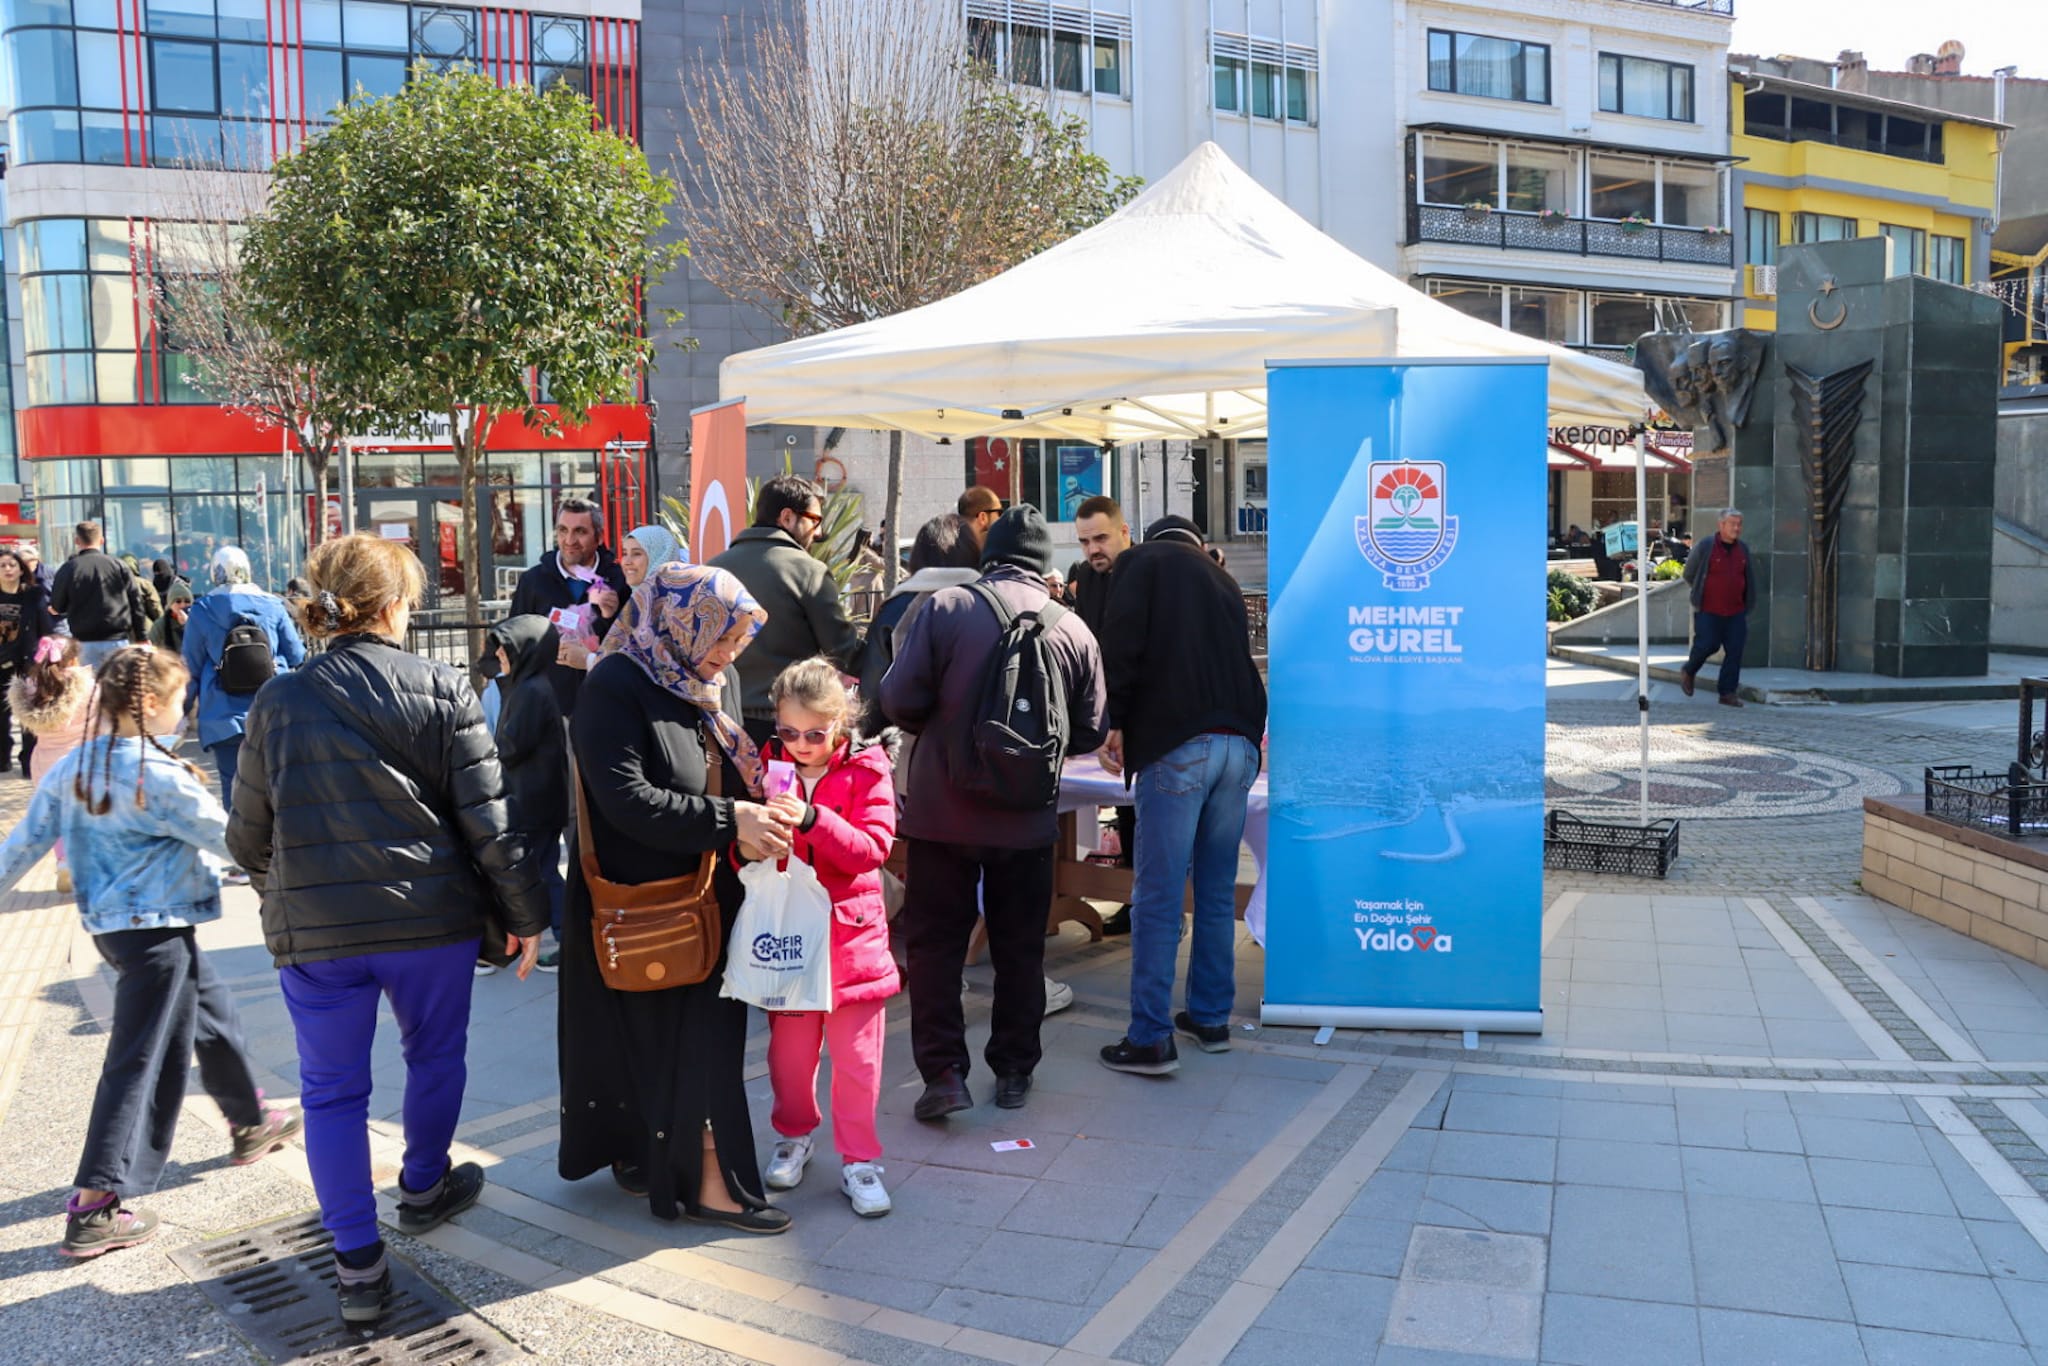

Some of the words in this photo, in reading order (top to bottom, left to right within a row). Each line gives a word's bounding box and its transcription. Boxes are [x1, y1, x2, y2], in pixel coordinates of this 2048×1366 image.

[1348, 606, 1464, 625] MEHMET
[1348, 627, 1463, 653] GÜREL
[1354, 899, 1403, 911] Yaşamak
[1405, 898, 1424, 912] İçin
[1354, 912, 1368, 923] En
[1370, 912, 1403, 925] Doğru
[1405, 914, 1432, 926] Şehir
